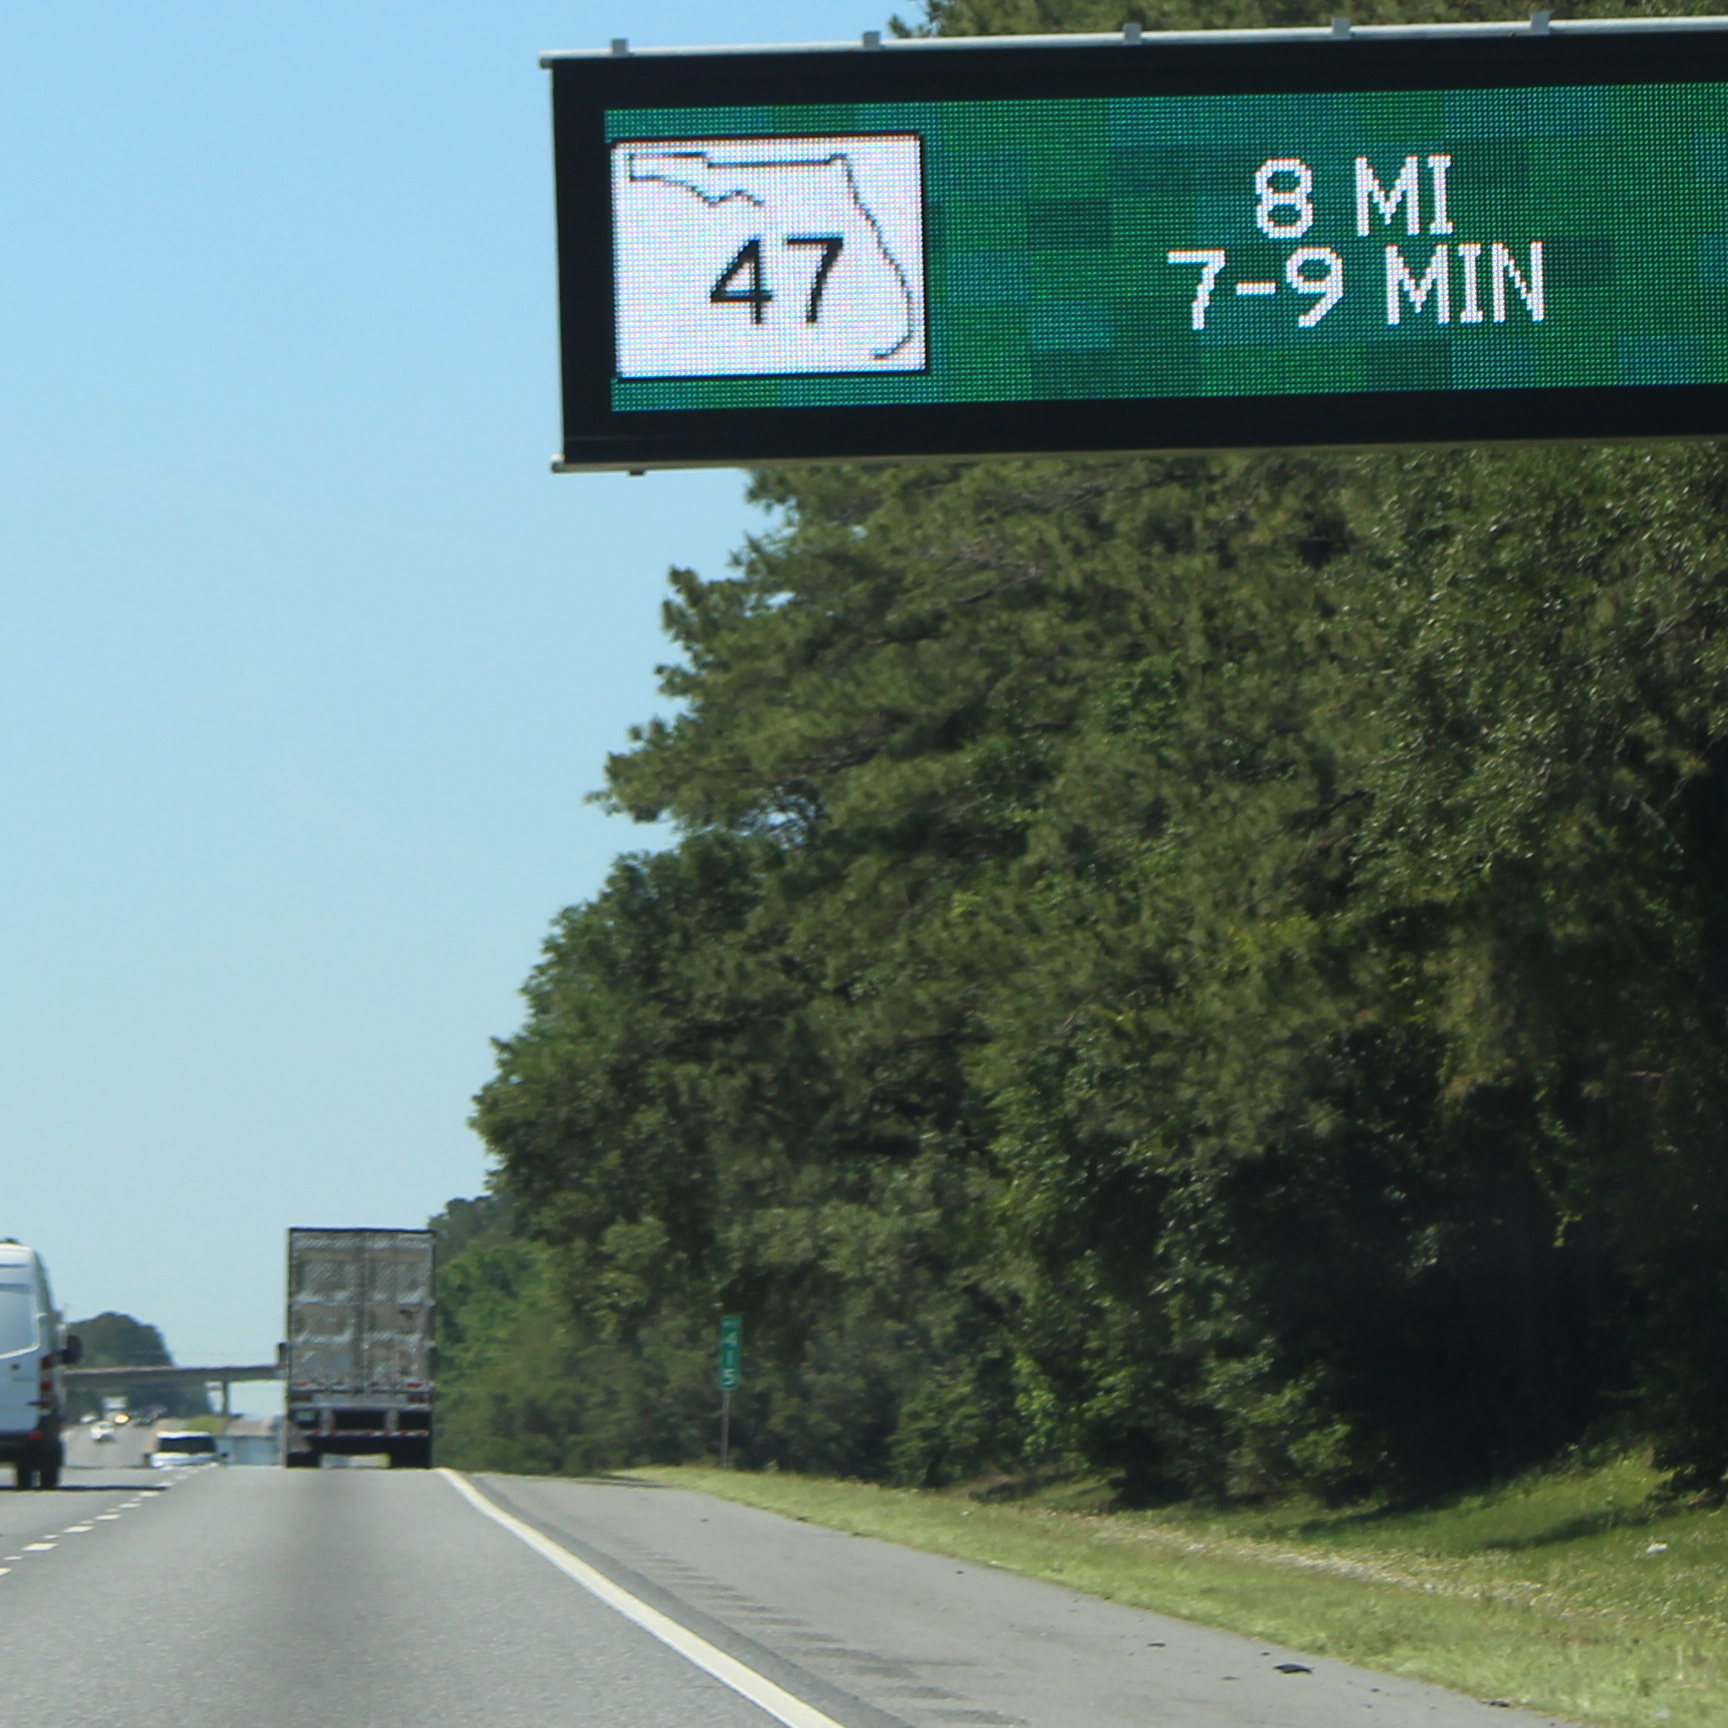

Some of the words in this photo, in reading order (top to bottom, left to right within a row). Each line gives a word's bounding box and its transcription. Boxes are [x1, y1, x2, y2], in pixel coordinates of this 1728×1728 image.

[1255, 157, 1314, 239] 8
[1355, 154, 1454, 237] MI
[710, 238, 844, 325] 47
[1167, 248, 1344, 331] 7-9
[1385, 241, 1545, 326] MIN
